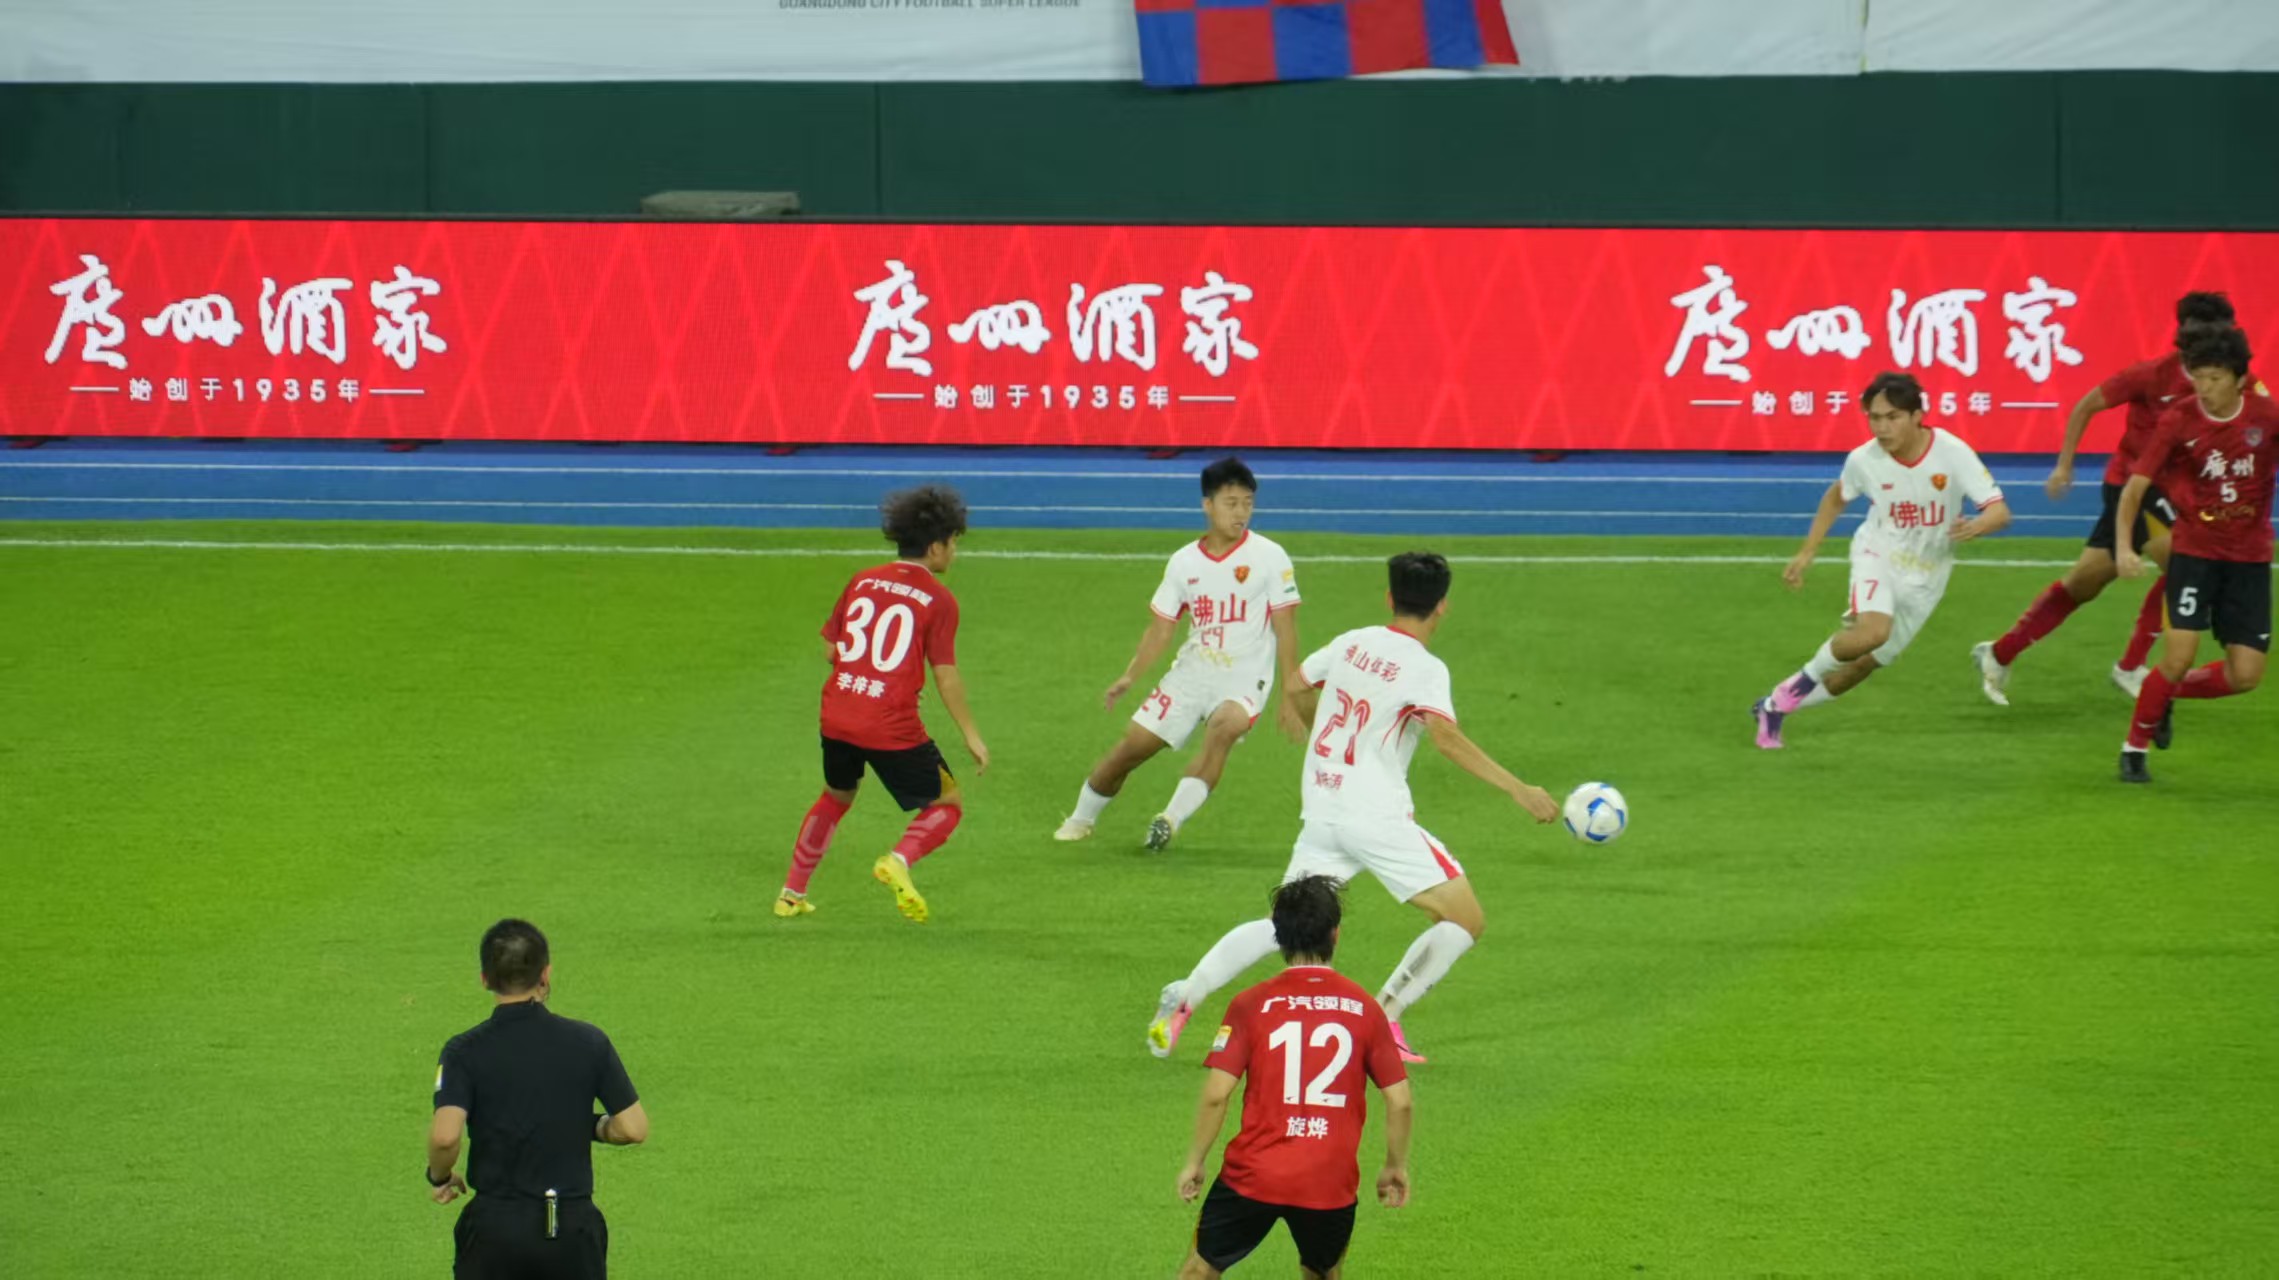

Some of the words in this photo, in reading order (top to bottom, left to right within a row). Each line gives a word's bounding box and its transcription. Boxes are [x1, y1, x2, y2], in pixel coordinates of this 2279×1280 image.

[129, 377, 360, 402] 始创于1935年
[934, 384, 1170, 409] 始创于1935年
[2219, 481, 2238, 503] 5
[1889, 501, 1945, 529] 佛山
[1864, 579, 1879, 601] 7
[2177, 587, 2198, 616] 5
[836, 596, 915, 673] 30
[1141, 687, 1173, 721] 29
[1313, 687, 1371, 766] 21
[1269, 1020, 1353, 1108] 12
